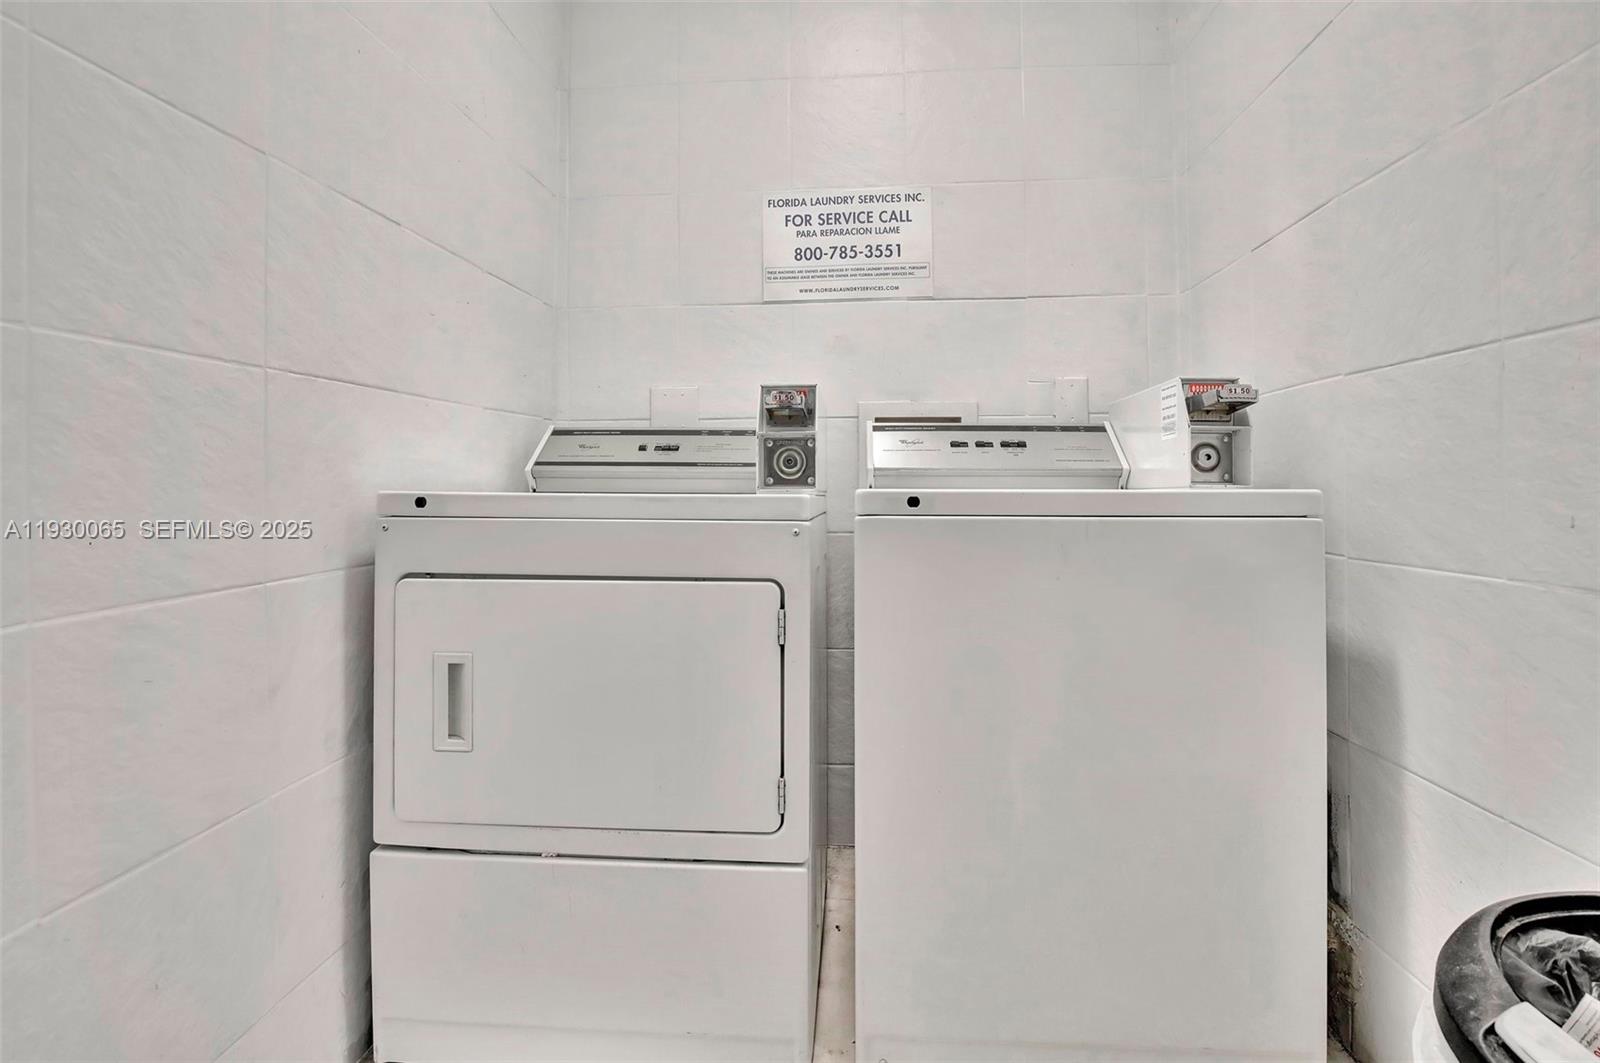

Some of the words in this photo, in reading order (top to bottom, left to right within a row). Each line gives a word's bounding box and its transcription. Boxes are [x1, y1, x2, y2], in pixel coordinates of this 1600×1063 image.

[767, 198, 807, 208] FLORIDA
[810, 195, 855, 207] LAUNDRY
[858, 194, 901, 205] SERVICES
[905, 193, 925, 203] INC.
[785, 214, 812, 227] FOR
[817, 211, 874, 226] SERVICE
[879, 210, 912, 223] CALL
[796, 229, 817, 238] PARA
[820, 227, 872, 237] REPARACION
[875, 226, 900, 235] LLAME
[794, 244, 902, 261] 800-785-3551
[799, 285, 900, 294] WWW.FLORIDALAUNDRYSERVICES.COM
